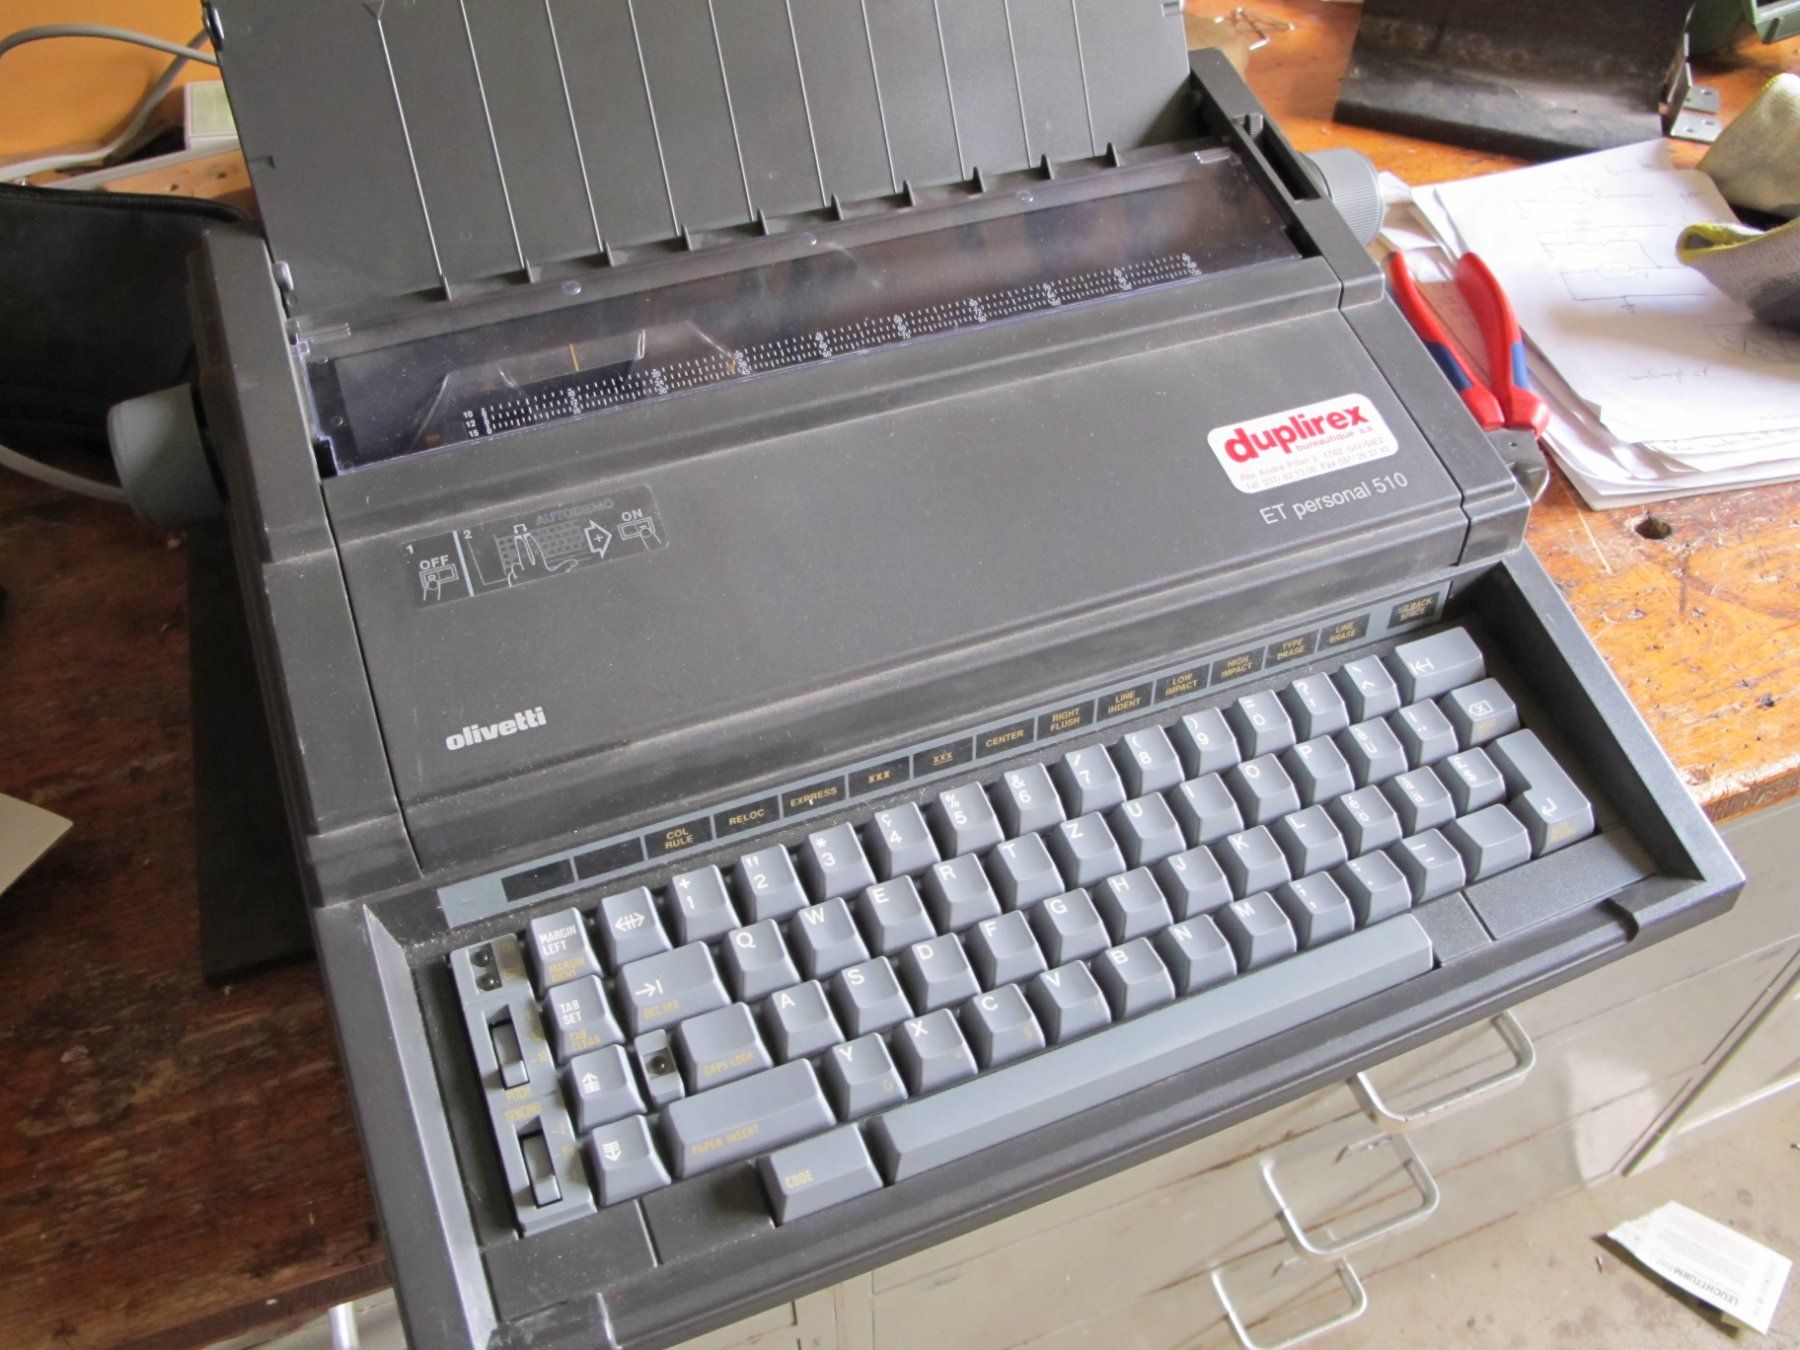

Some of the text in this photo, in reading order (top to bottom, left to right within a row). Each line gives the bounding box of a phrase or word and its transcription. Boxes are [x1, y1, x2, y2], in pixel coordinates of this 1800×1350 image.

[463, 410, 473, 418] 10
[466, 420, 476, 428] 12
[469, 430, 479, 438] 15
[1224, 405, 1369, 463] duplirex
[1259, 472, 1409, 525] ET personal 510
[621, 508, 643, 522] ON
[463, 529, 473, 540] 2
[406, 544, 414, 555] 1
[419, 554, 449, 570] OFF
[1281, 638, 1303, 651] TYPE
[1276, 645, 1305, 661] ERASE
[1227, 655, 1249, 668] HIGH
[1220, 662, 1253, 679] IMPACT
[1172, 673, 1194, 686] LOW
[1165, 680, 1199, 697] IMPACT
[1115, 691, 1136, 703] LINE
[1108, 698, 1141, 714] INDENT
[1053, 707, 1080, 722] RIGHT
[445, 706, 547, 751] olivetti
[1050, 716, 1080, 732] FLUSH
[986, 729, 1025, 748] CENTER
[1197, 732, 1210, 746] 9
[1138, 751, 1152, 765] 8
[1297, 745, 1313, 760] P
[1079, 770, 1093, 784] 7
[1245, 764, 1260, 779] O
[1010, 774, 1026, 789] &
[790, 786, 838, 807] EXPRESS
[944, 794, 960, 809] %
[1018, 790, 1033, 804] 6
[729, 809, 765, 826] RELOC
[954, 811, 968, 825] 5
[1126, 802, 1143, 818] U
[1066, 822, 1084, 840] Z
[1291, 817, 1307, 829] L
[666, 828, 689, 841] COL
[890, 830, 903, 844] 4
[1232, 835, 1249, 850] K
[664, 836, 694, 850] RULE
[1003, 843, 1016, 859] T
[822, 852, 836, 867] 3
[1171, 857, 1187, 871] J
[938, 865, 957, 881] R
[754, 874, 769, 890] 2
[1111, 876, 1131, 893] H
[686, 895, 696, 910] 1
[872, 887, 890, 904] E
[1049, 899, 1069, 915] G
[1235, 902, 1256, 918] M
[804, 907, 825, 926] W
[538, 924, 577, 944] MARGIN
[981, 920, 997, 938] F
[1174, 926, 1193, 942] N
[541, 940, 567, 956] LEFT
[736, 932, 756, 949] Q
[916, 944, 934, 960] D
[1110, 950, 1129, 965] B
[848, 969, 865, 985] S
[1045, 971, 1061, 987] V
[558, 1000, 580, 1014] TAB
[780, 992, 796, 1009] A
[981, 996, 999, 1011] C
[562, 1011, 582, 1026] SET
[908, 1020, 928, 1038] X
[839, 1046, 853, 1062] Y
[703, 1053, 754, 1076] CAPS LOCK
[692, 1124, 760, 1155] PAPER INSERT
[785, 1169, 814, 1189] CODE
